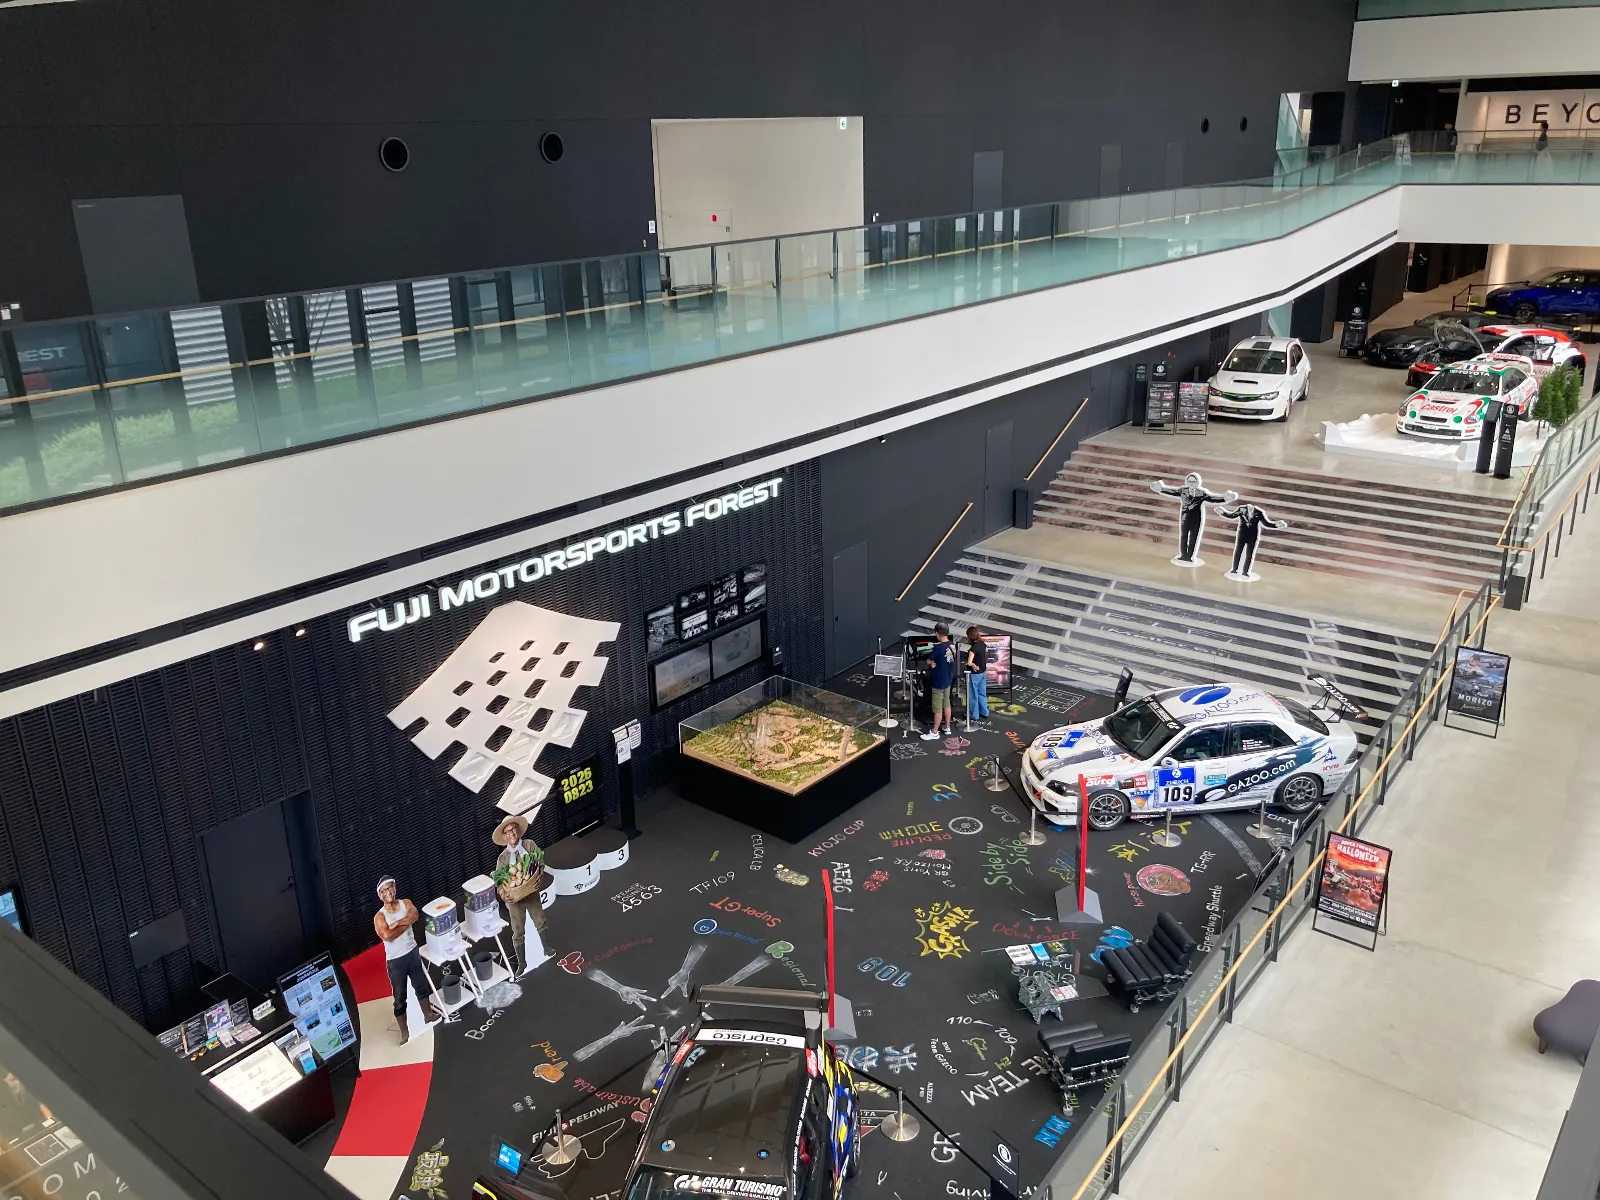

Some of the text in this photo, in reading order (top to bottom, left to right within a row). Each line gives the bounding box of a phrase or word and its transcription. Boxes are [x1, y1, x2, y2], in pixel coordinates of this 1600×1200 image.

[1420, 403, 1459, 414] Castrol
[348, 478, 783, 643] FUJI MOTORSPORTS FOREST
[1457, 693, 1493, 707] MORIZO
[561, 767, 592, 792] 2026
[1227, 759, 1296, 793] GAZOO.com
[563, 780, 594, 805] 0823
[1163, 786, 1193, 803] 109
[808, 819, 865, 857] KYOJO CUP
[618, 848, 625, 860] 3
[1337, 844, 1380, 863] HALLOWEEN
[585, 865, 592, 876] 1
[688, 871, 735, 895] TF109
[540, 892, 548, 904] 2
[741, 905, 782, 928] Super
[1197, 885, 1223, 953] Speedway Shuttle
[464, 1009, 506, 1041] Boom
[946, 1016, 973, 1025] 110
[712, 1032, 788, 1045] Capristo
[994, 1027, 1018, 1044] 109
[960, 1069, 1030, 1106] TEAM
[701, 1176, 732, 1190] GRAN
[735, 1178, 784, 1197] TURISMO
